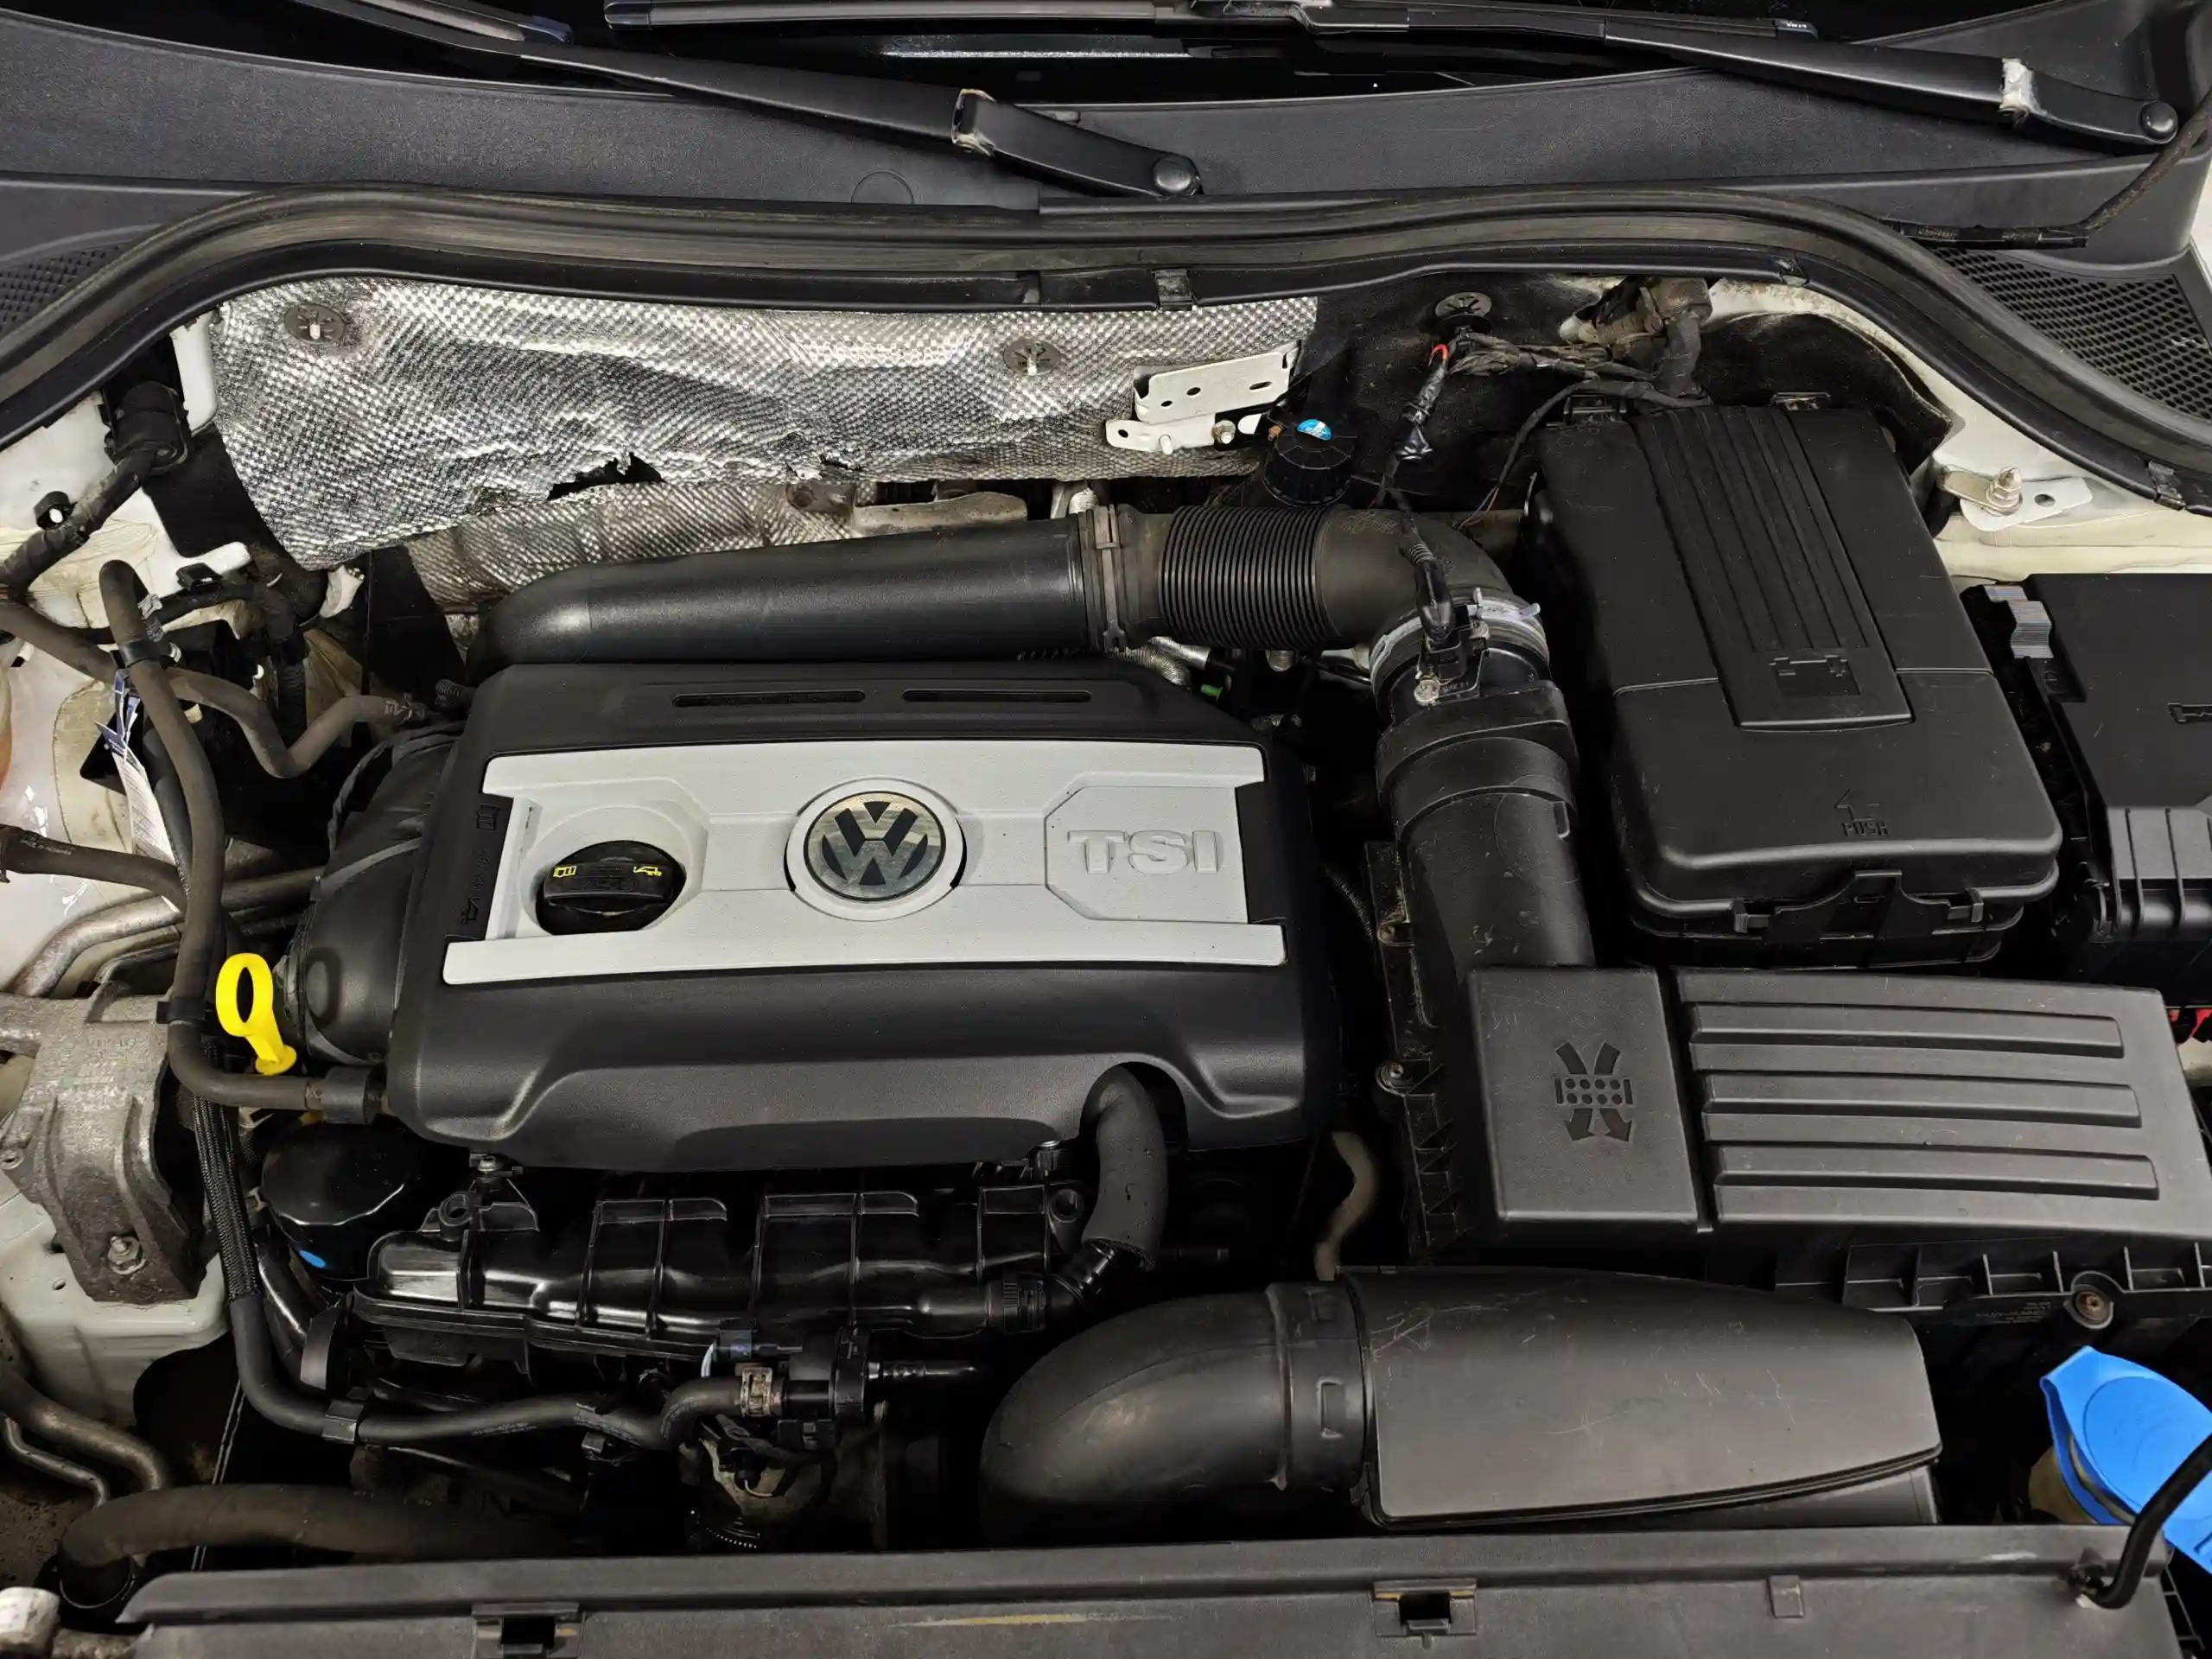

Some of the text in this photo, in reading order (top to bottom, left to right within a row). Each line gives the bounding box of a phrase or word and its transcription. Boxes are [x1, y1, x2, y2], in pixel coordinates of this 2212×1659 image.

[807, 793, 943, 899] VW
[1840, 821, 1891, 836] PUSH
[1067, 829, 1220, 875] TSI
